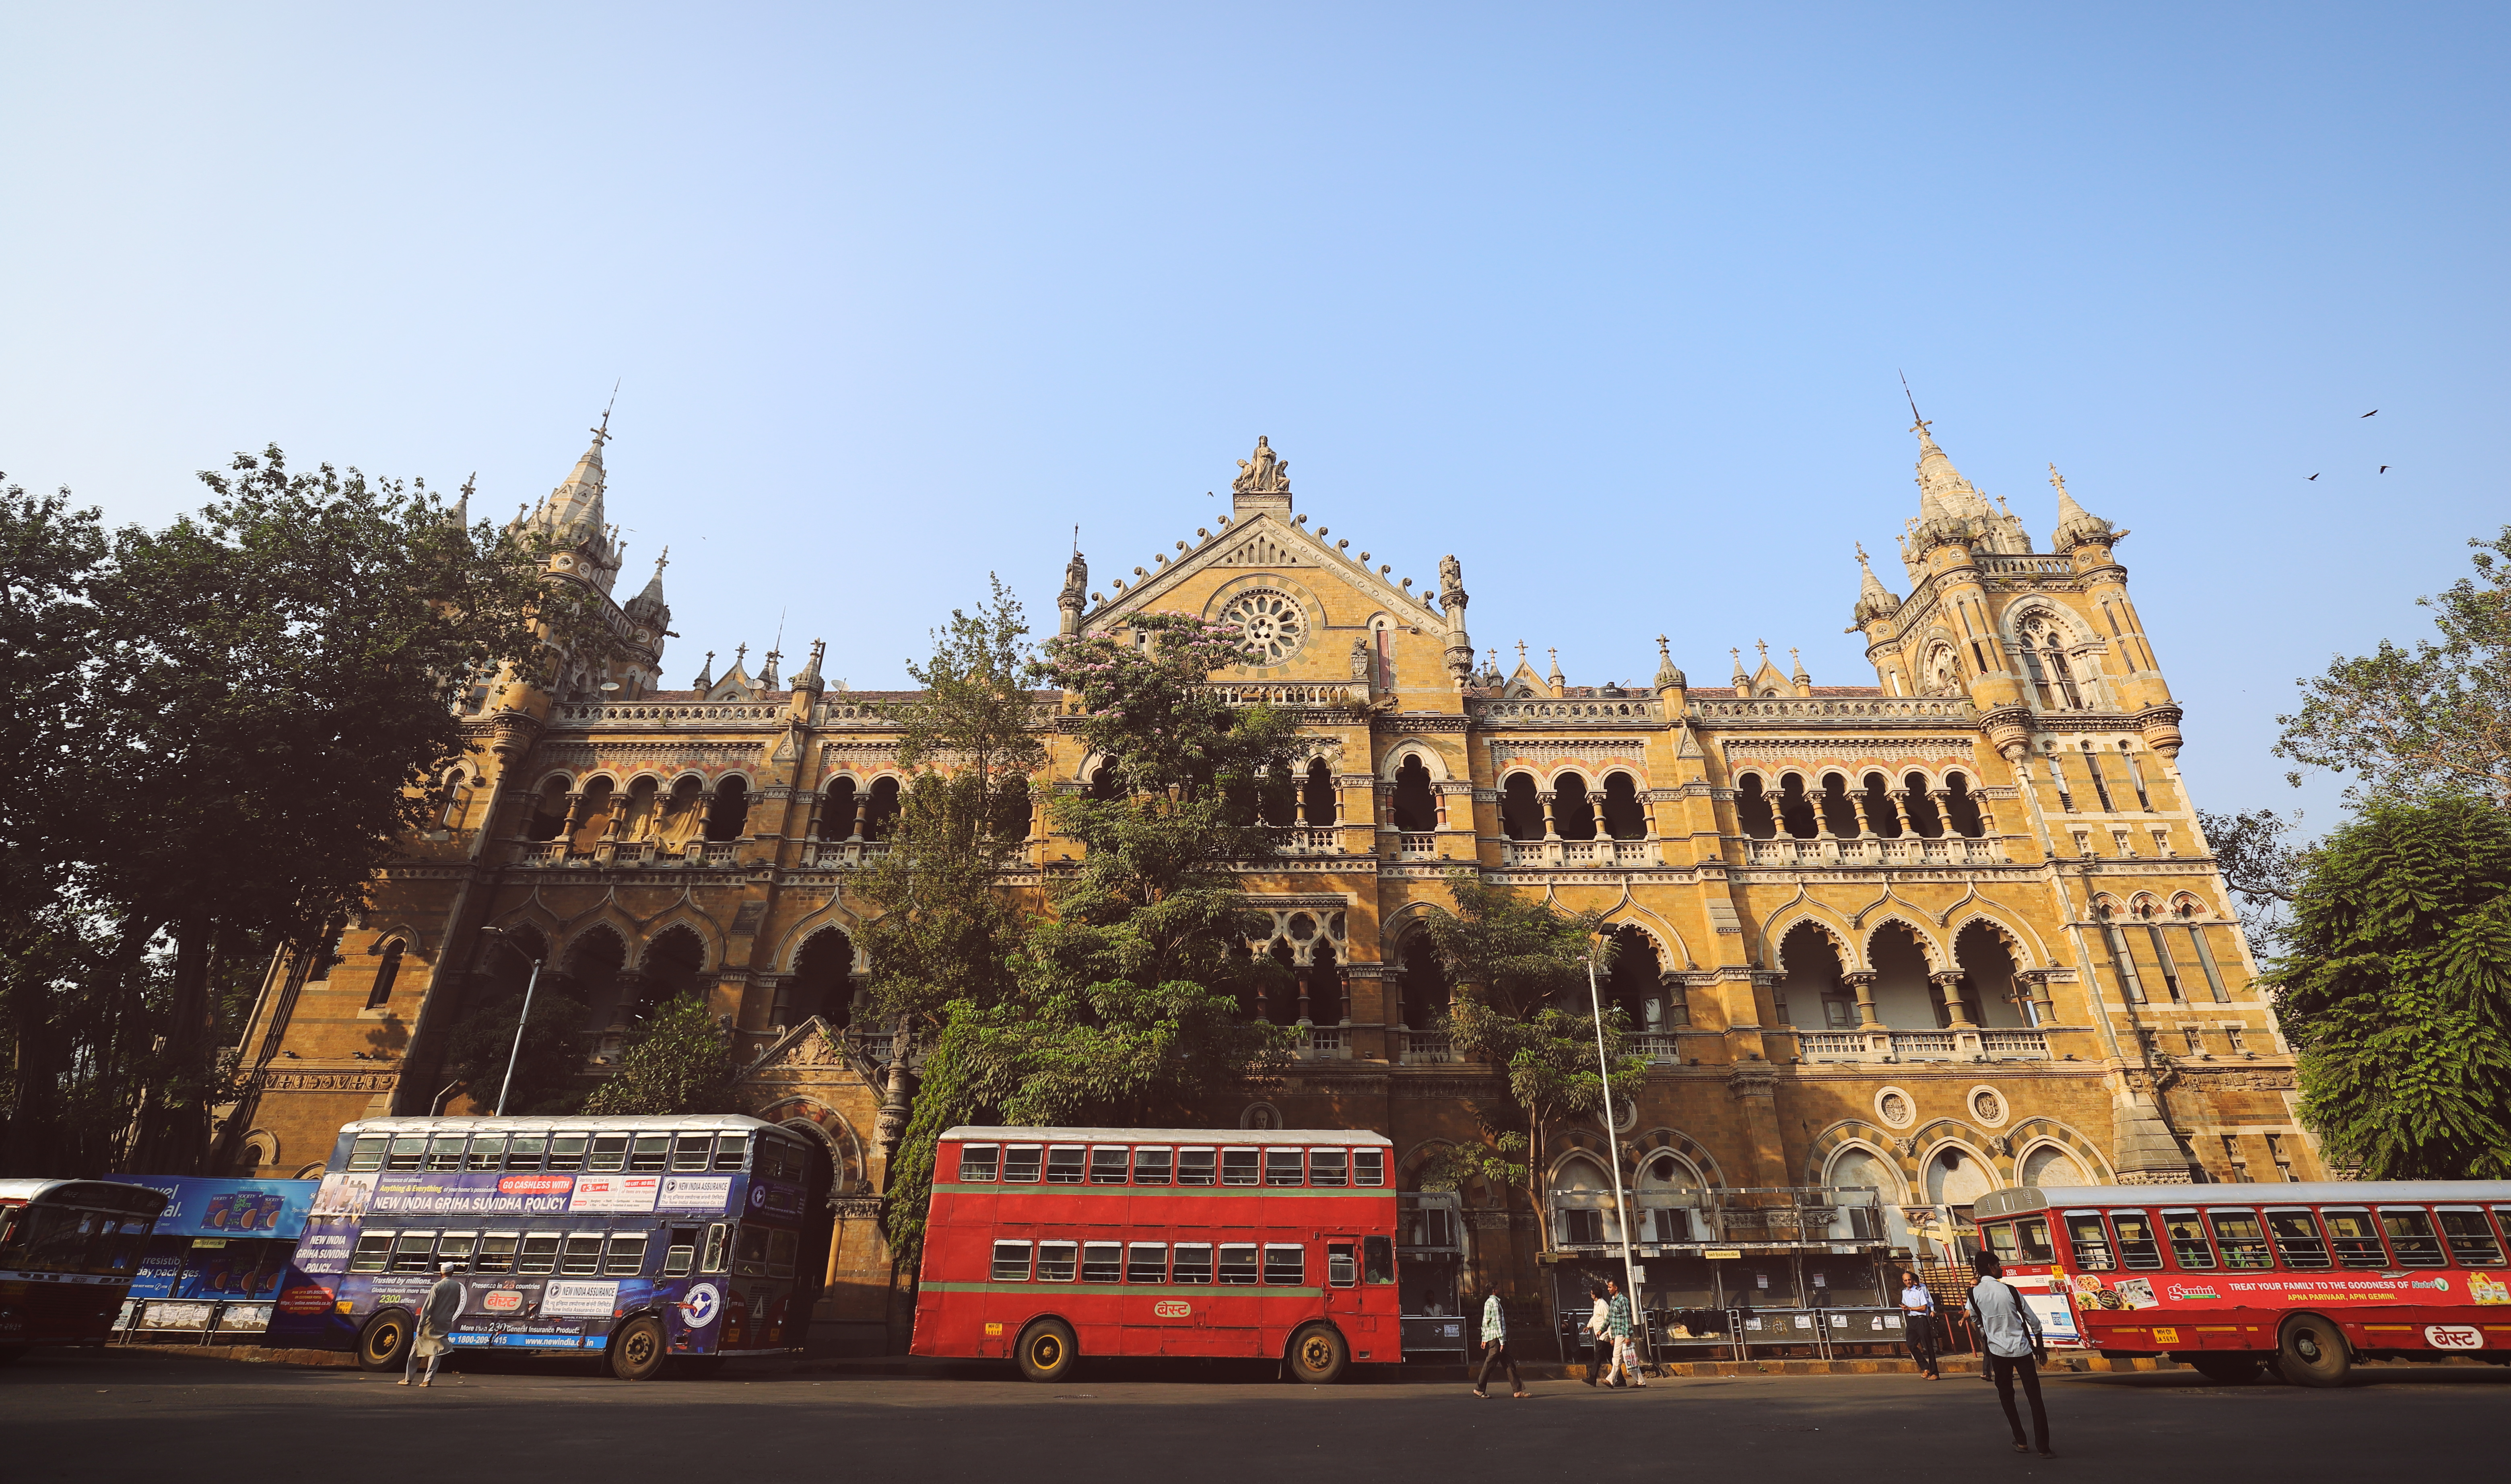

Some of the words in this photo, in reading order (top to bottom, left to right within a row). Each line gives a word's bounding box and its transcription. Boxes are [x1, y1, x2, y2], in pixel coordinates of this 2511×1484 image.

[379, 1185, 406, 1193] Anything
[412, 1185, 443, 1194] Everything
[503, 1181, 513, 1189] GO
[514, 1181, 551, 1189] CASHLESS
[552, 1181, 570, 1189] WITH
[701, 1183, 728, 1191] ASSURANCE
[373, 1197, 401, 1209] NEW
[401, 1197, 432, 1210] INDIA
[435, 1197, 470, 1210] GRIHA
[472, 1197, 522, 1210] SUVIDHA
[524, 1197, 567, 1210] POLICY
[309, 1235, 326, 1245] NEW
[326, 1235, 346, 1245] INDIA
[296, 1249, 318, 1259] GRIHA
[318, 1249, 350, 1259] SUVIDHA
[143, 1256, 189, 1266] rresistib
[154, 1267, 201, 1279] packges.
[305, 1263, 332, 1273] POLICY
[396, 1277, 406, 1285] by
[2229, 1282, 2256, 1291] TREAT
[2257, 1282, 2282, 1291] YOUR
[2283, 1282, 2314, 1290] FAMILY
[2315, 1282, 2328, 1290] TO
[2328, 1281, 2347, 1289] THE
[2348, 1281, 2396, 1289] GOODNESS
[2397, 1281, 2409, 1289] OF
[562, 1286, 573, 1296] NEW
[573, 1287, 586, 1296] INDIA
[587, 1287, 615, 1297] ASSURANCE
[379, 1295, 401, 1303] 2300
[487, 1293, 519, 1307] बेस्ट
[1157, 1301, 1188, 1315] बेस्ट
[2432, 1326, 2475, 1347] बेस्ट
[525, 1338, 594, 1347] www.newindia.c.in
